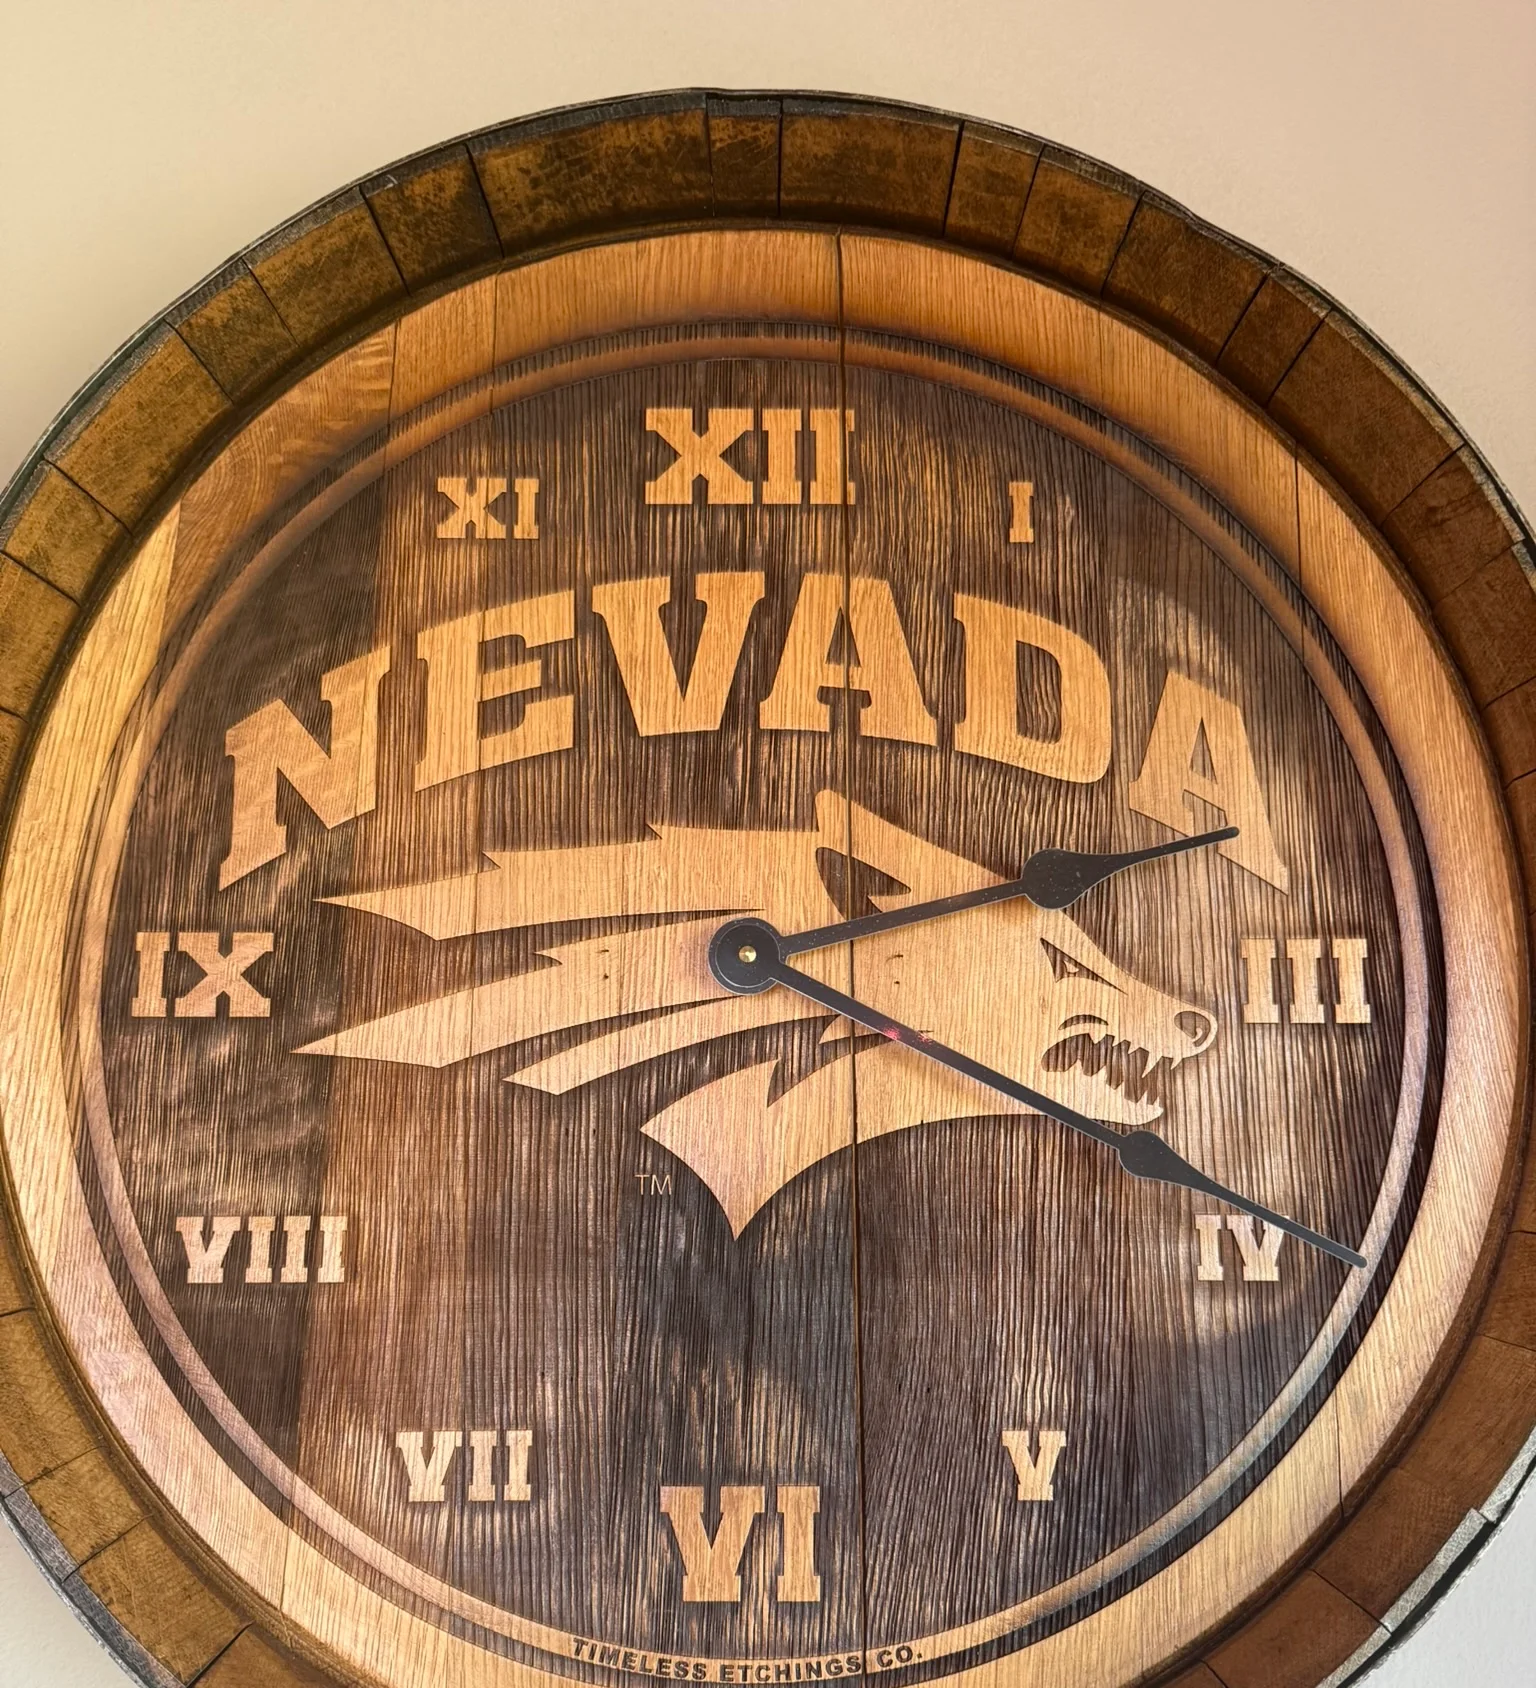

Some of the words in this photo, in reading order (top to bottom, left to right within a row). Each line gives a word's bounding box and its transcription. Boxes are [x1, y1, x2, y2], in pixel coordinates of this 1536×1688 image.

[645, 408, 855, 504] XII
[437, 477, 539, 539] XI
[1009, 481, 1034, 543] I
[218, 571, 1289, 896] NEVADA
[131, 932, 274, 1018] IX
[1241, 938, 1372, 1024] III
[635, 1174, 673, 1196] TM
[176, 1215, 348, 1284] VIII
[1195, 1214, 1290, 1282] IV
[397, 1429, 533, 1502] VII
[1002, 1430, 1067, 1501] V
[660, 1485, 820, 1602] VI
[573, 1637, 707, 1680] TIMELESS
[719, 1655, 862, 1682] ETCHINGS
[877, 1644, 923, 1667] CO.
